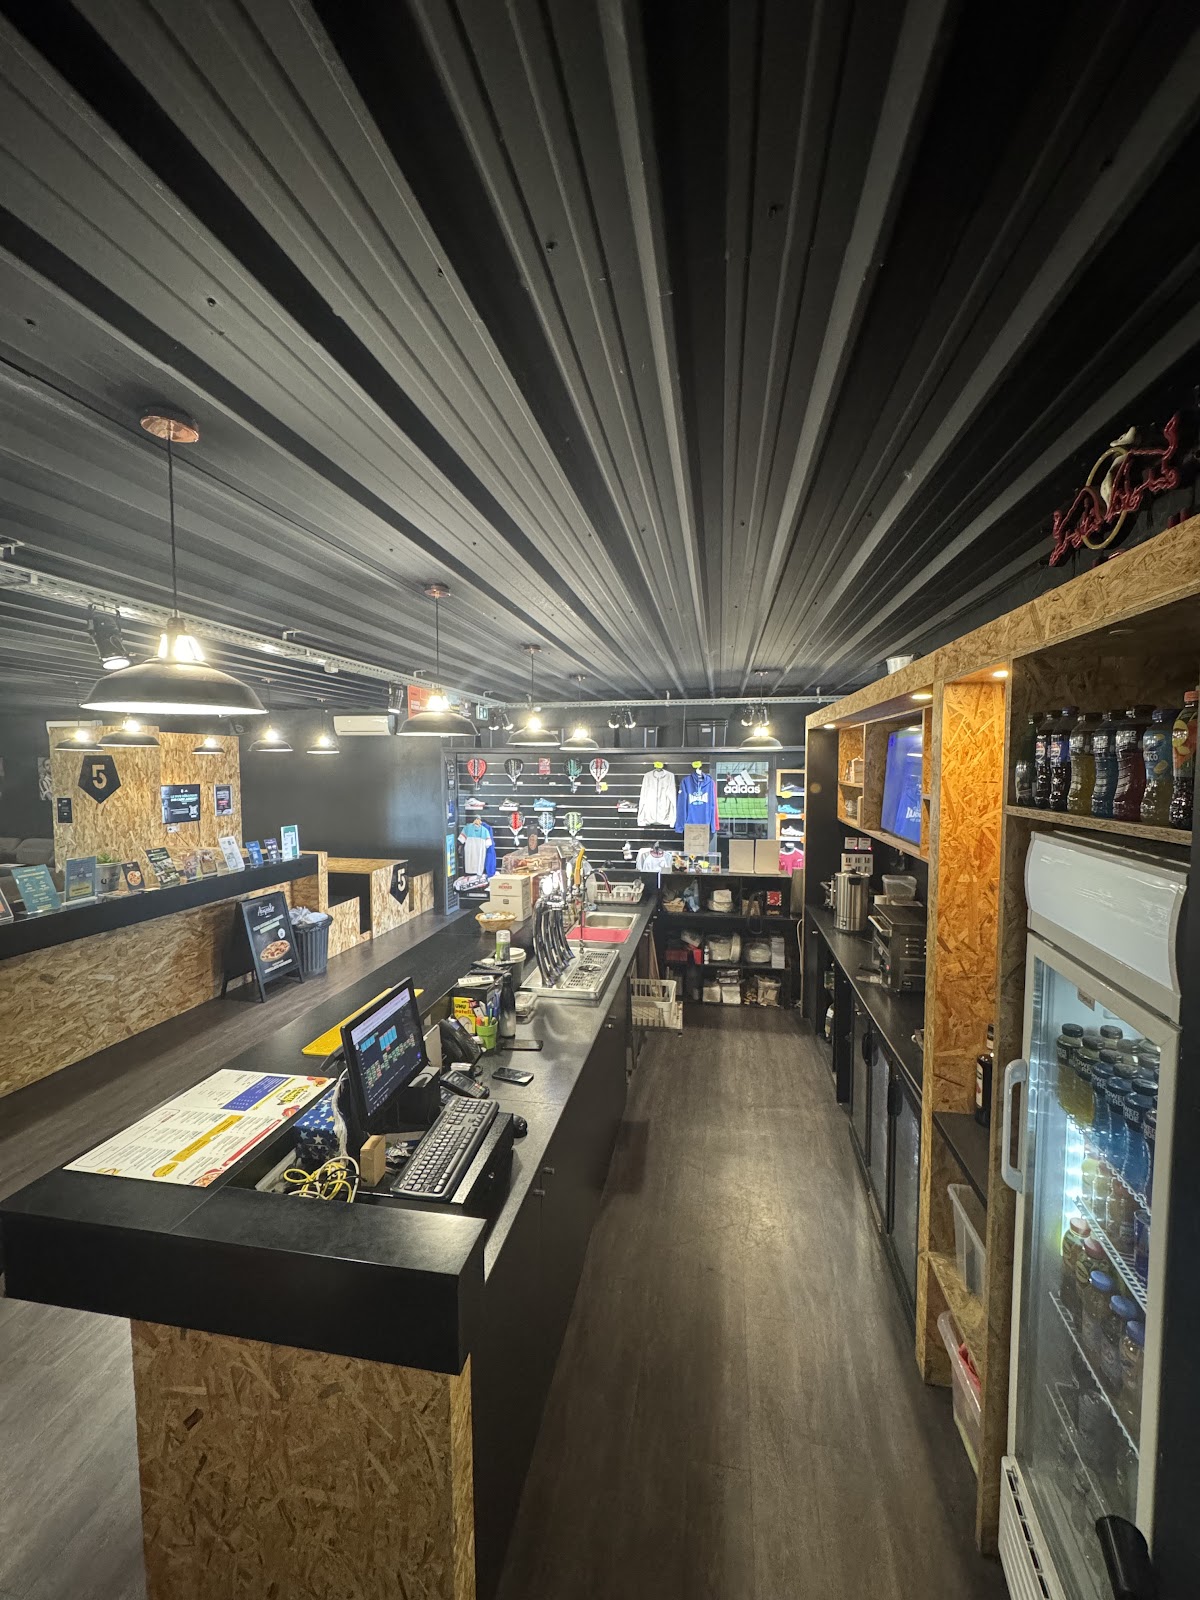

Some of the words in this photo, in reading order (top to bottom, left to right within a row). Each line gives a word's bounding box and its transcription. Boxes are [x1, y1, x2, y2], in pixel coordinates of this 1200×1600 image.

[91, 764, 108, 790] 5
[723, 784, 761, 794] adidas
[397, 868, 406, 892] 5
[1123, 1104, 1140, 1117] WER
